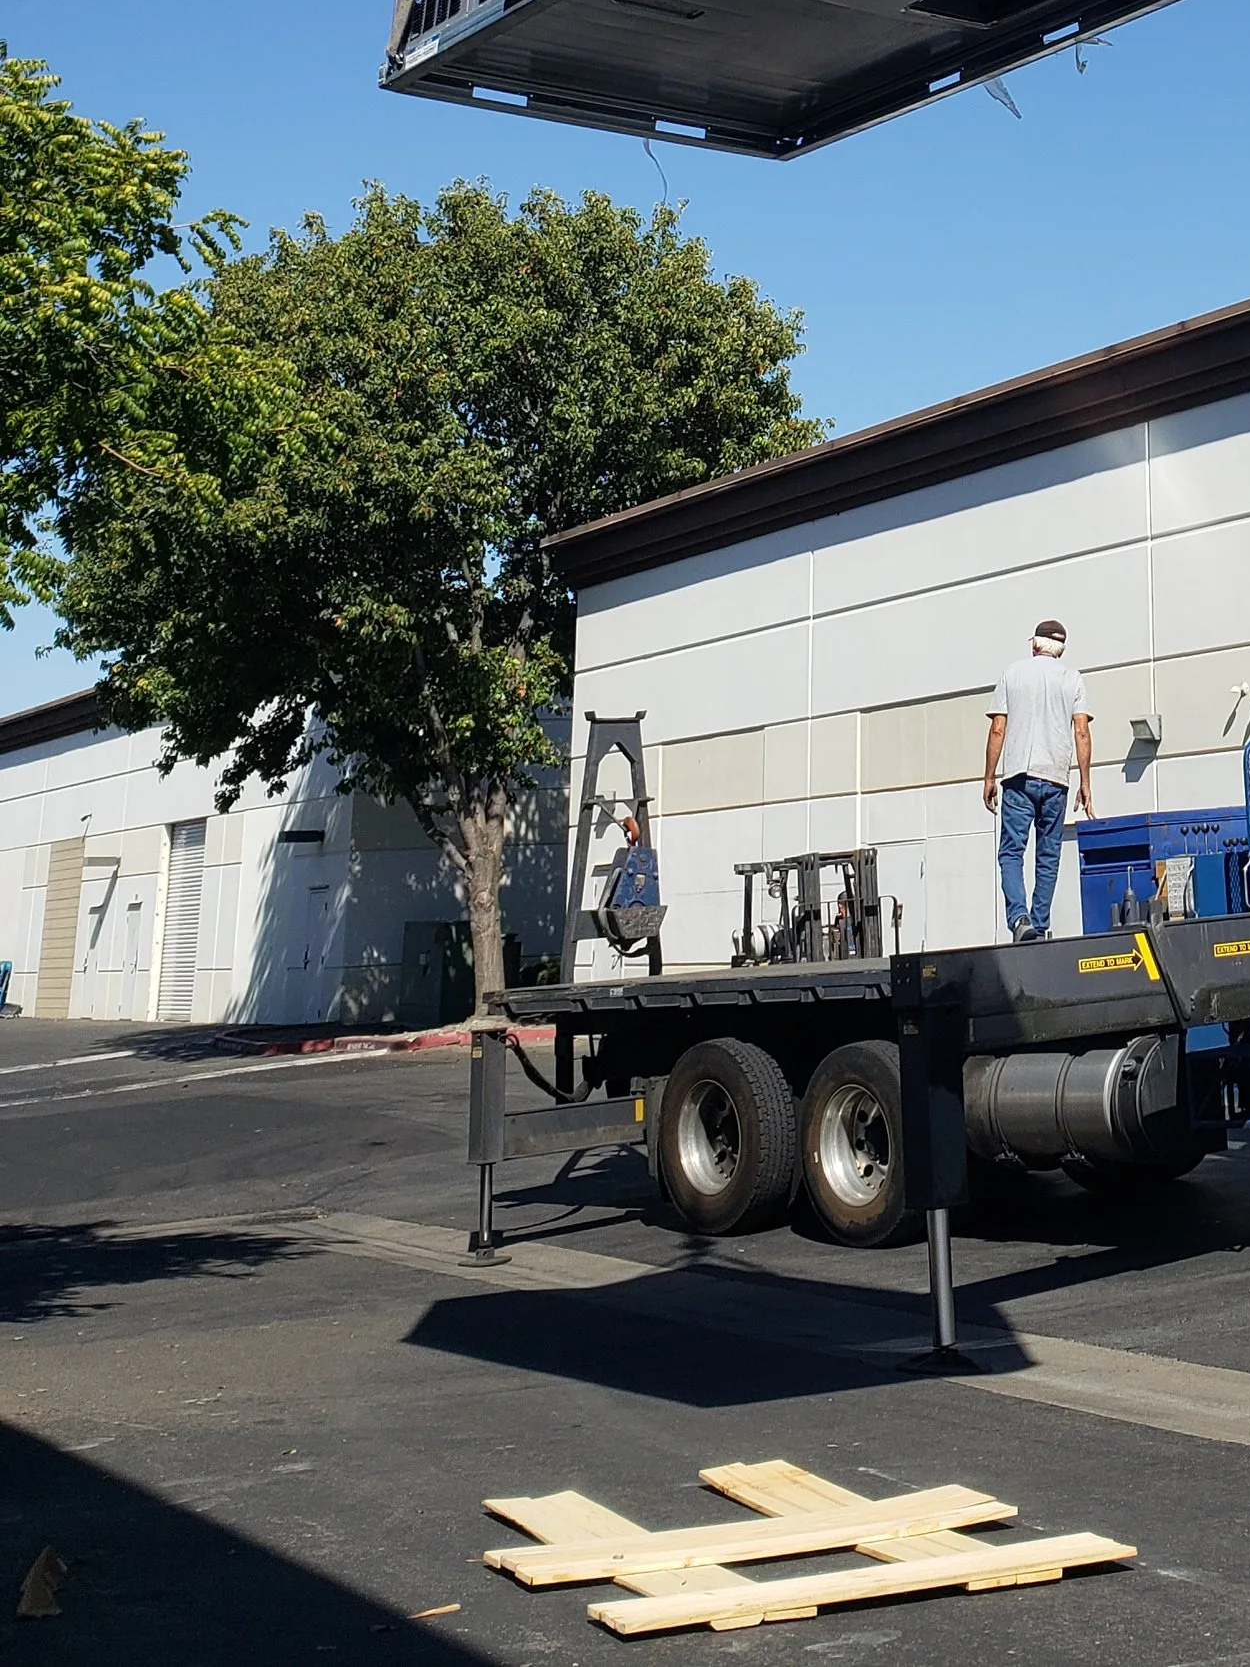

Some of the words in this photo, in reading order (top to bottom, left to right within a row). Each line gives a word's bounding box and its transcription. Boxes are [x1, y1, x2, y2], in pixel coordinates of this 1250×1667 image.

[1216, 946, 1238, 954] EXTEND
[1082, 961, 1105, 969] EXTEND
[1116, 956, 1133, 965] MARK
